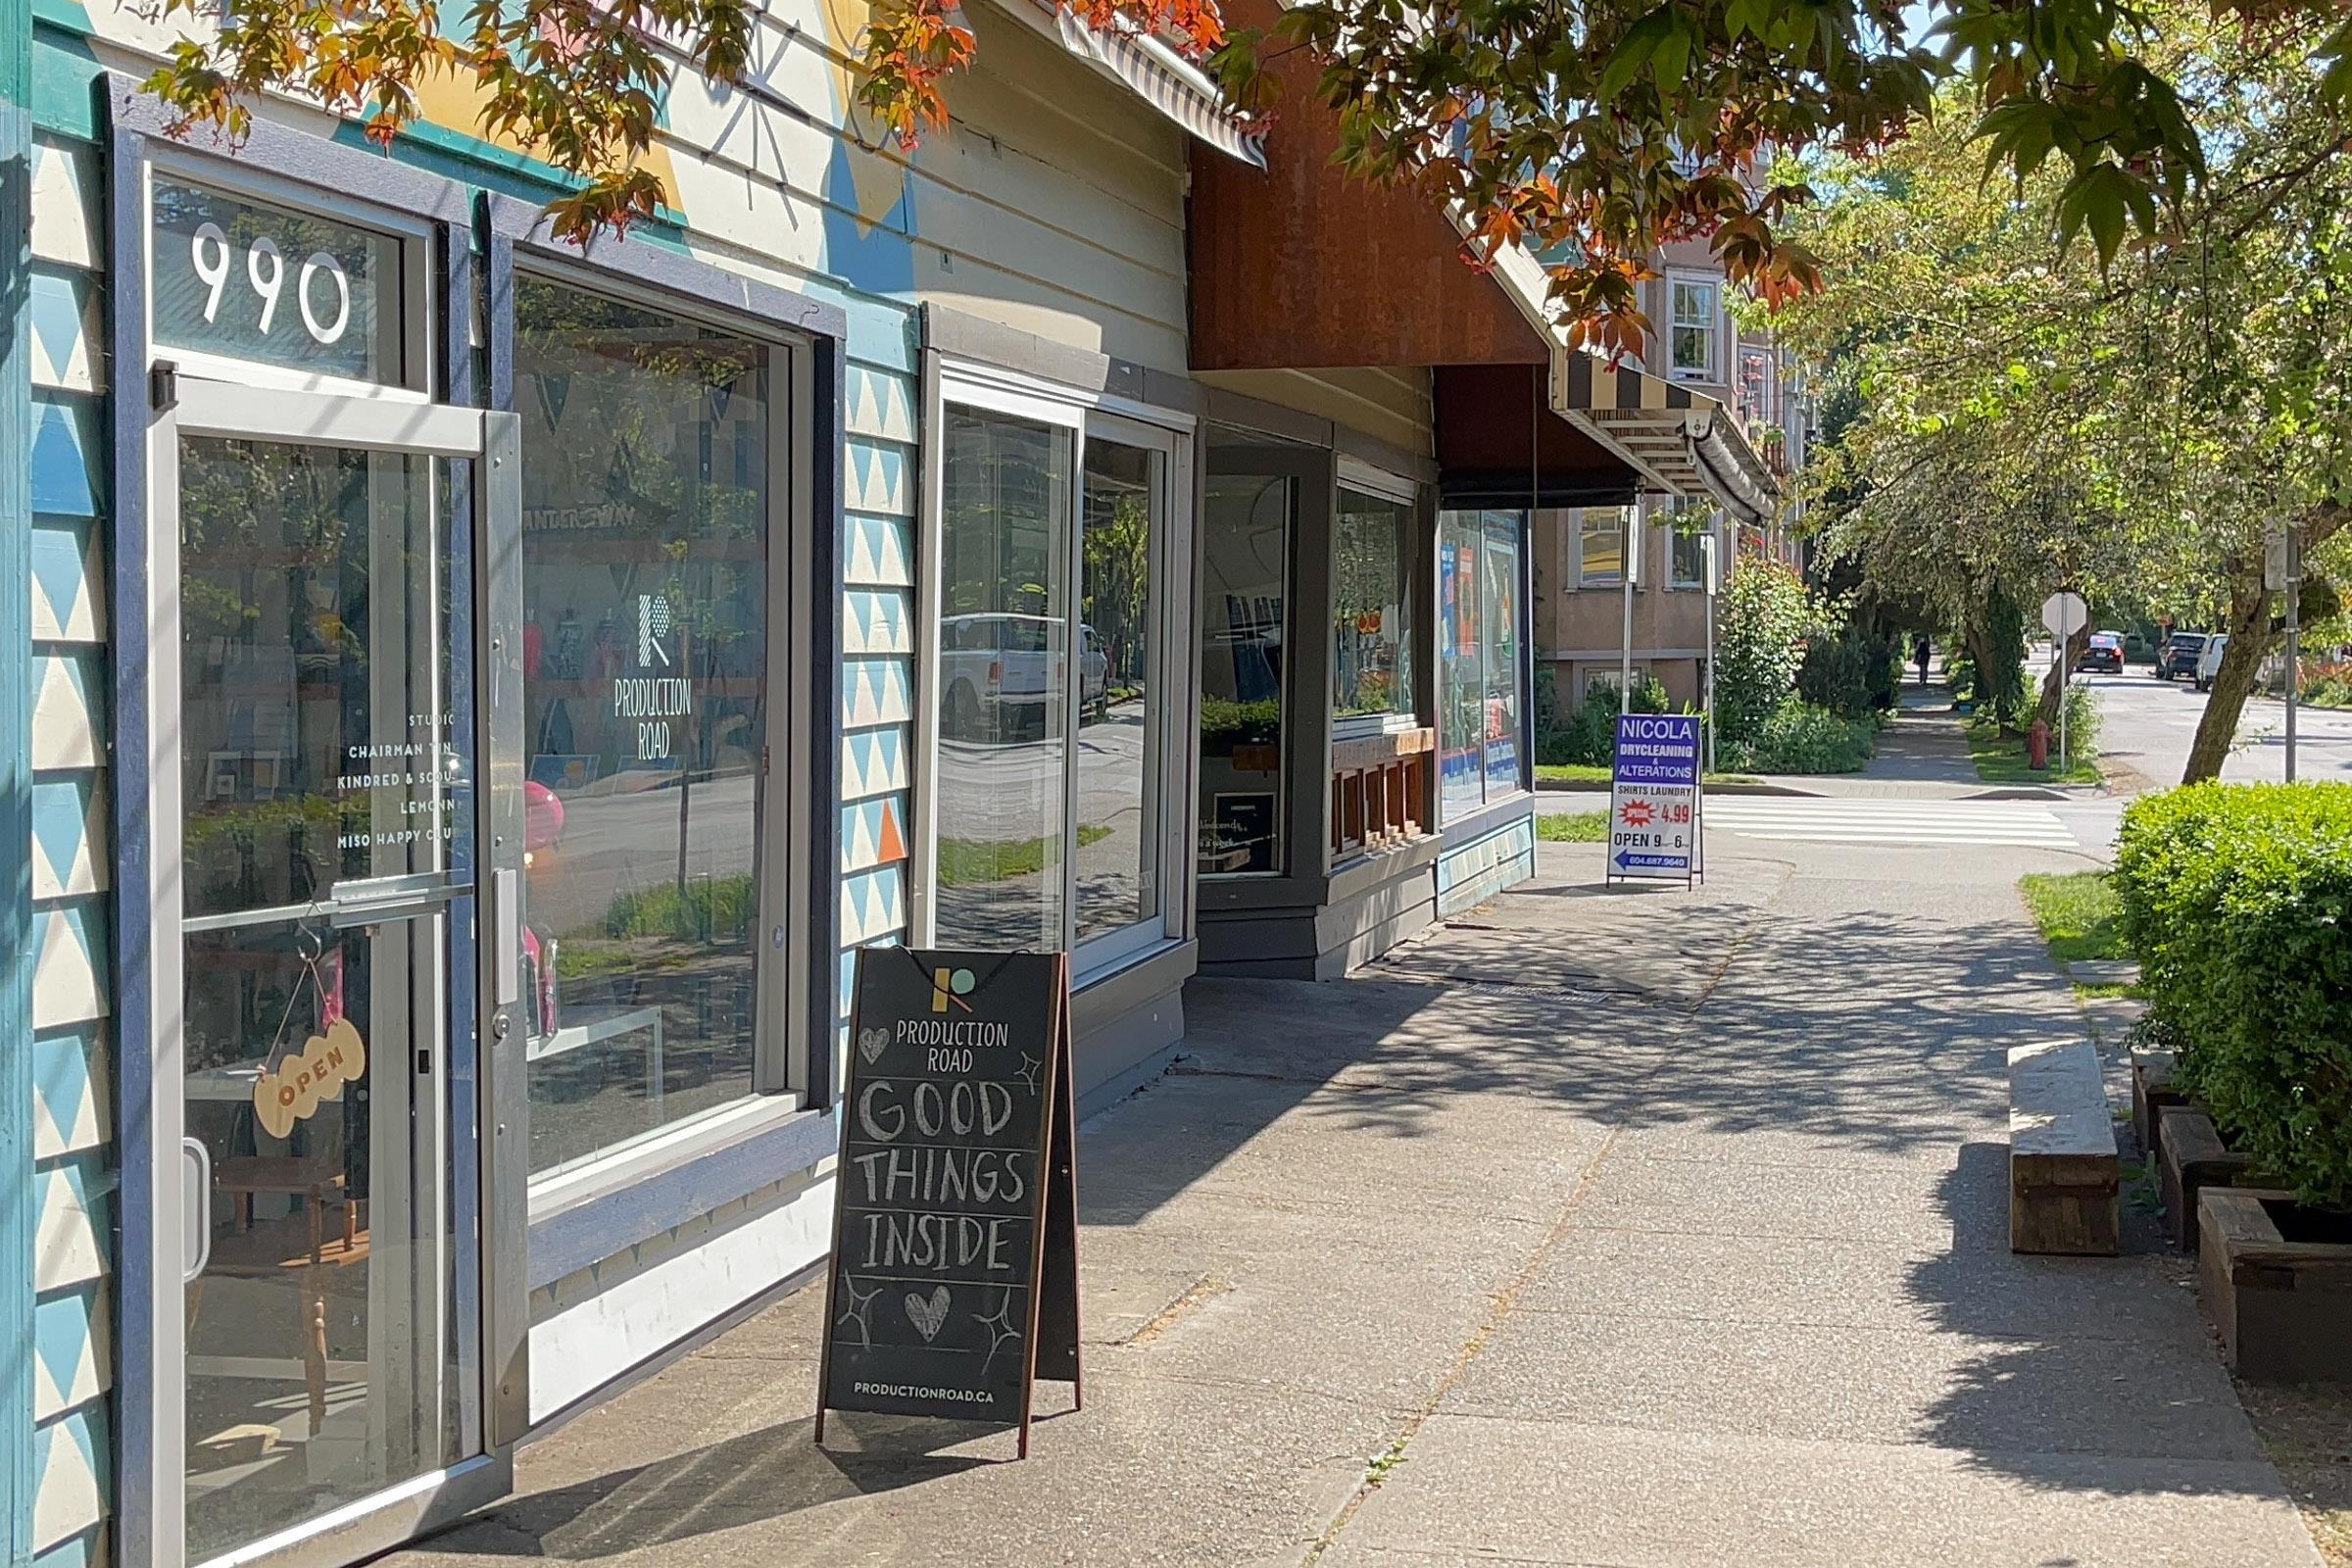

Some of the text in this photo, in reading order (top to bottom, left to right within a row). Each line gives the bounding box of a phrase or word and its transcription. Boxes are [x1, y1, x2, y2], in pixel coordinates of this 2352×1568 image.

[191, 221, 350, 344] 990
[614, 678, 691, 716] PRODUCTION
[638, 721, 669, 760] ROAD
[1622, 719, 1692, 739] NICOLA
[349, 743, 423, 759] CHAIRMAN
[1619, 743, 1693, 758] DRYCLEANING
[337, 772, 400, 789] KINDRED
[406, 772, 413, 785] &
[1619, 764, 1692, 779] ALTERATIONS
[1618, 785, 1691, 797] SHIRTS LAUNDRY
[337, 833, 370, 849] MISO
[376, 830, 420, 845] HAPPY
[1614, 832, 1649, 848] OPEN
[1653, 834, 1661, 848] 9
[1675, 835, 1683, 849] 6
[896, 1019, 1008, 1047] PRODUCTION
[927, 1048, 973, 1073] ROAD
[278, 1046, 344, 1106] OPEN
[858, 1080, 1012, 1142] GOOD
[853, 1149, 1024, 1204] THINGS
[861, 1213, 1012, 1271] INSIDE
[854, 1382, 994, 1403] PRODUCTIONROAD.CA
